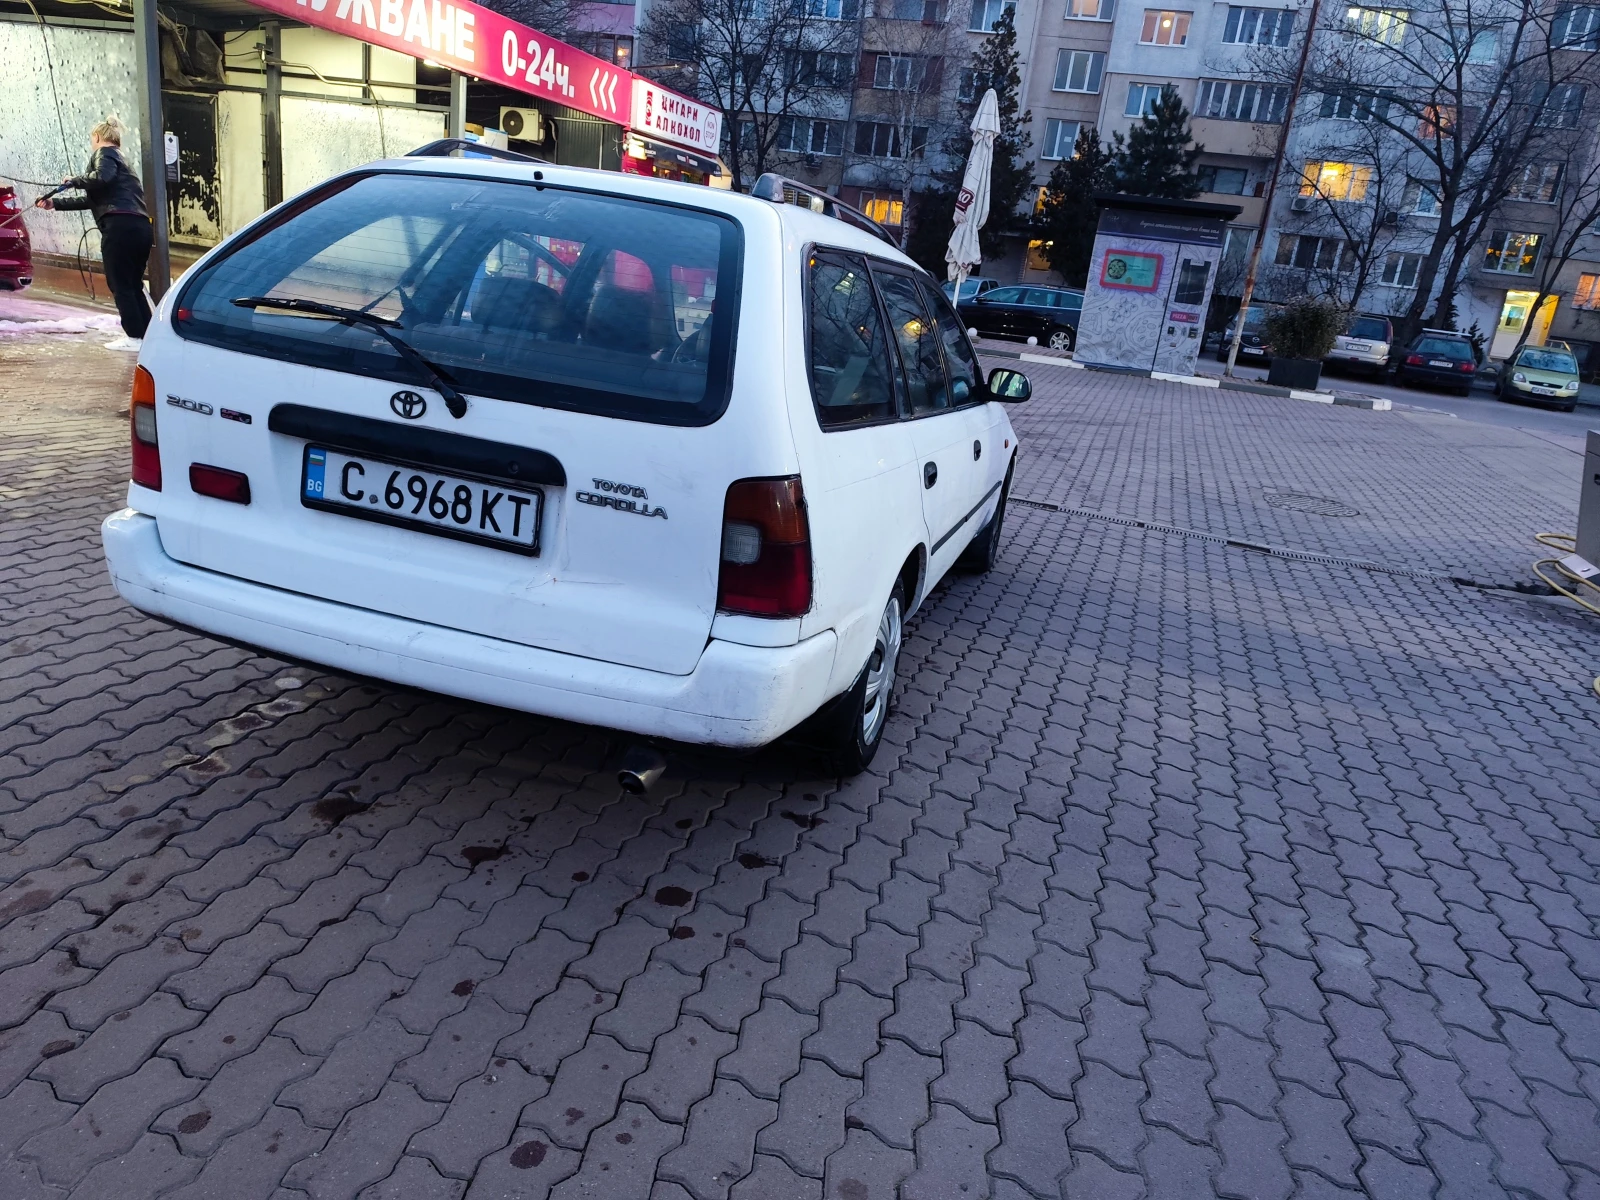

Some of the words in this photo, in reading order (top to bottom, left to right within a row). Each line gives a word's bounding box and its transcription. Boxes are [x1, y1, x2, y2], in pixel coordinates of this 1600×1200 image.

[661, 94, 698, 122] ЦИГАРИ
[656, 115, 701, 142] АЛКОХОЛ
[706, 130, 715, 139] STOP
[707, 120, 715, 130] NON
[307, 478, 323, 493] BG
[592, 477, 648, 500] TOYOTA
[576, 489, 668, 520] COROLLA
